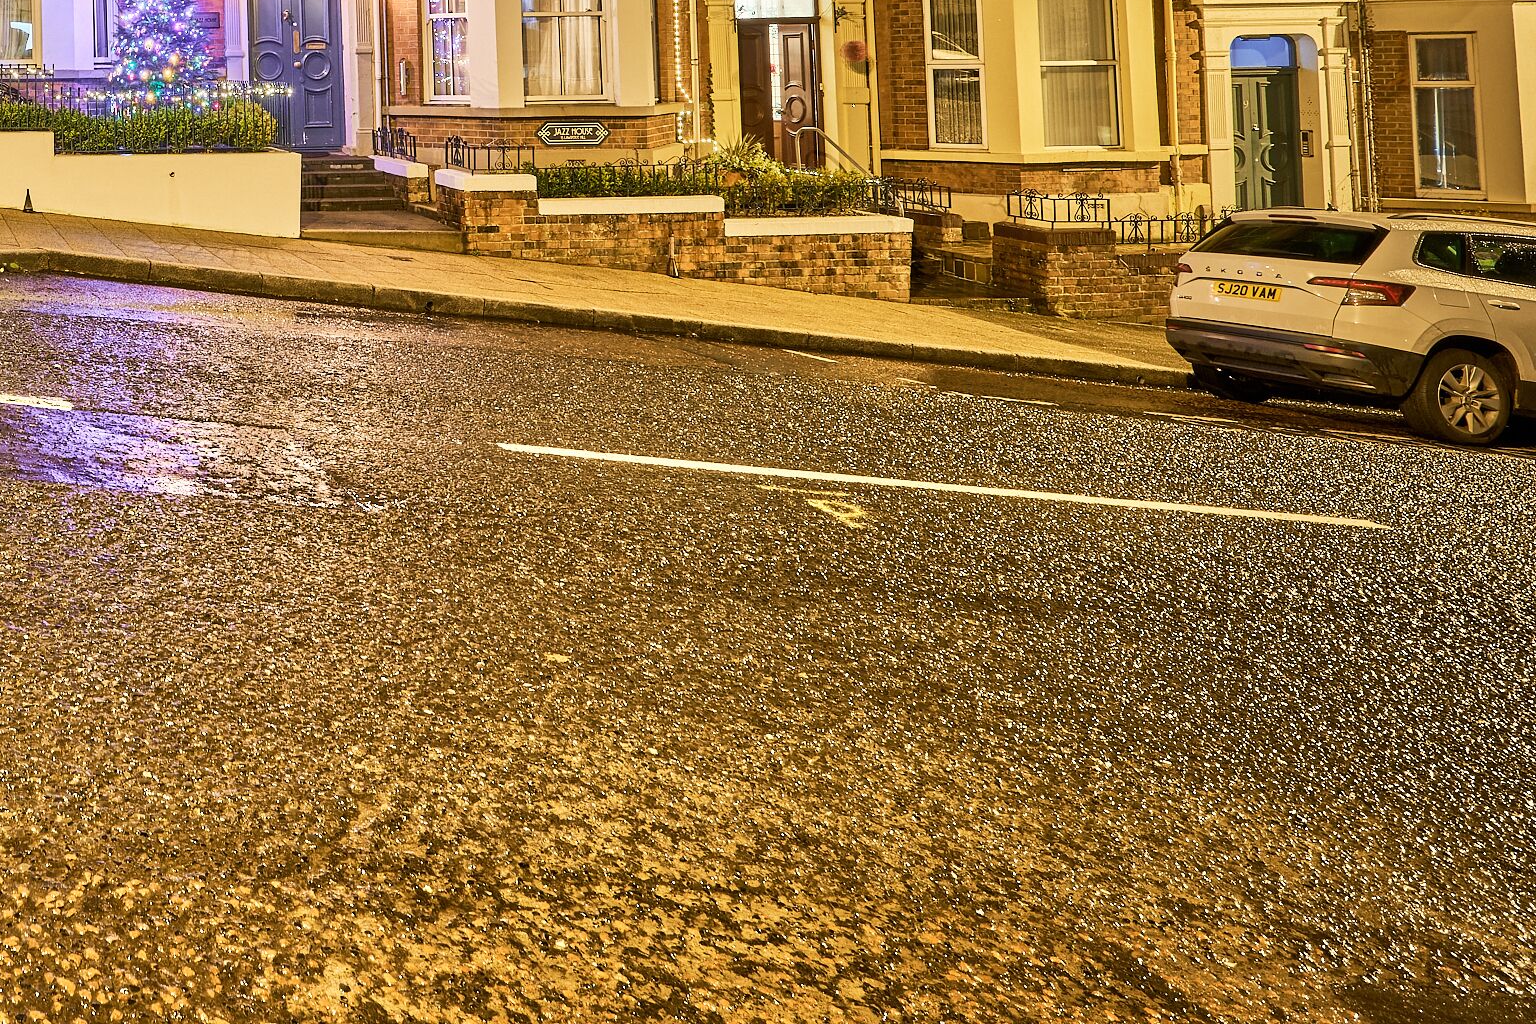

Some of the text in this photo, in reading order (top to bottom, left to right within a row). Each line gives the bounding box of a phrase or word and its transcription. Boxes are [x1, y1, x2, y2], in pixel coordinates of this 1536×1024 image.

[553, 127, 593, 137] JAZZ HOUSE
[1217, 282, 1277, 300] SJ20 VAM
